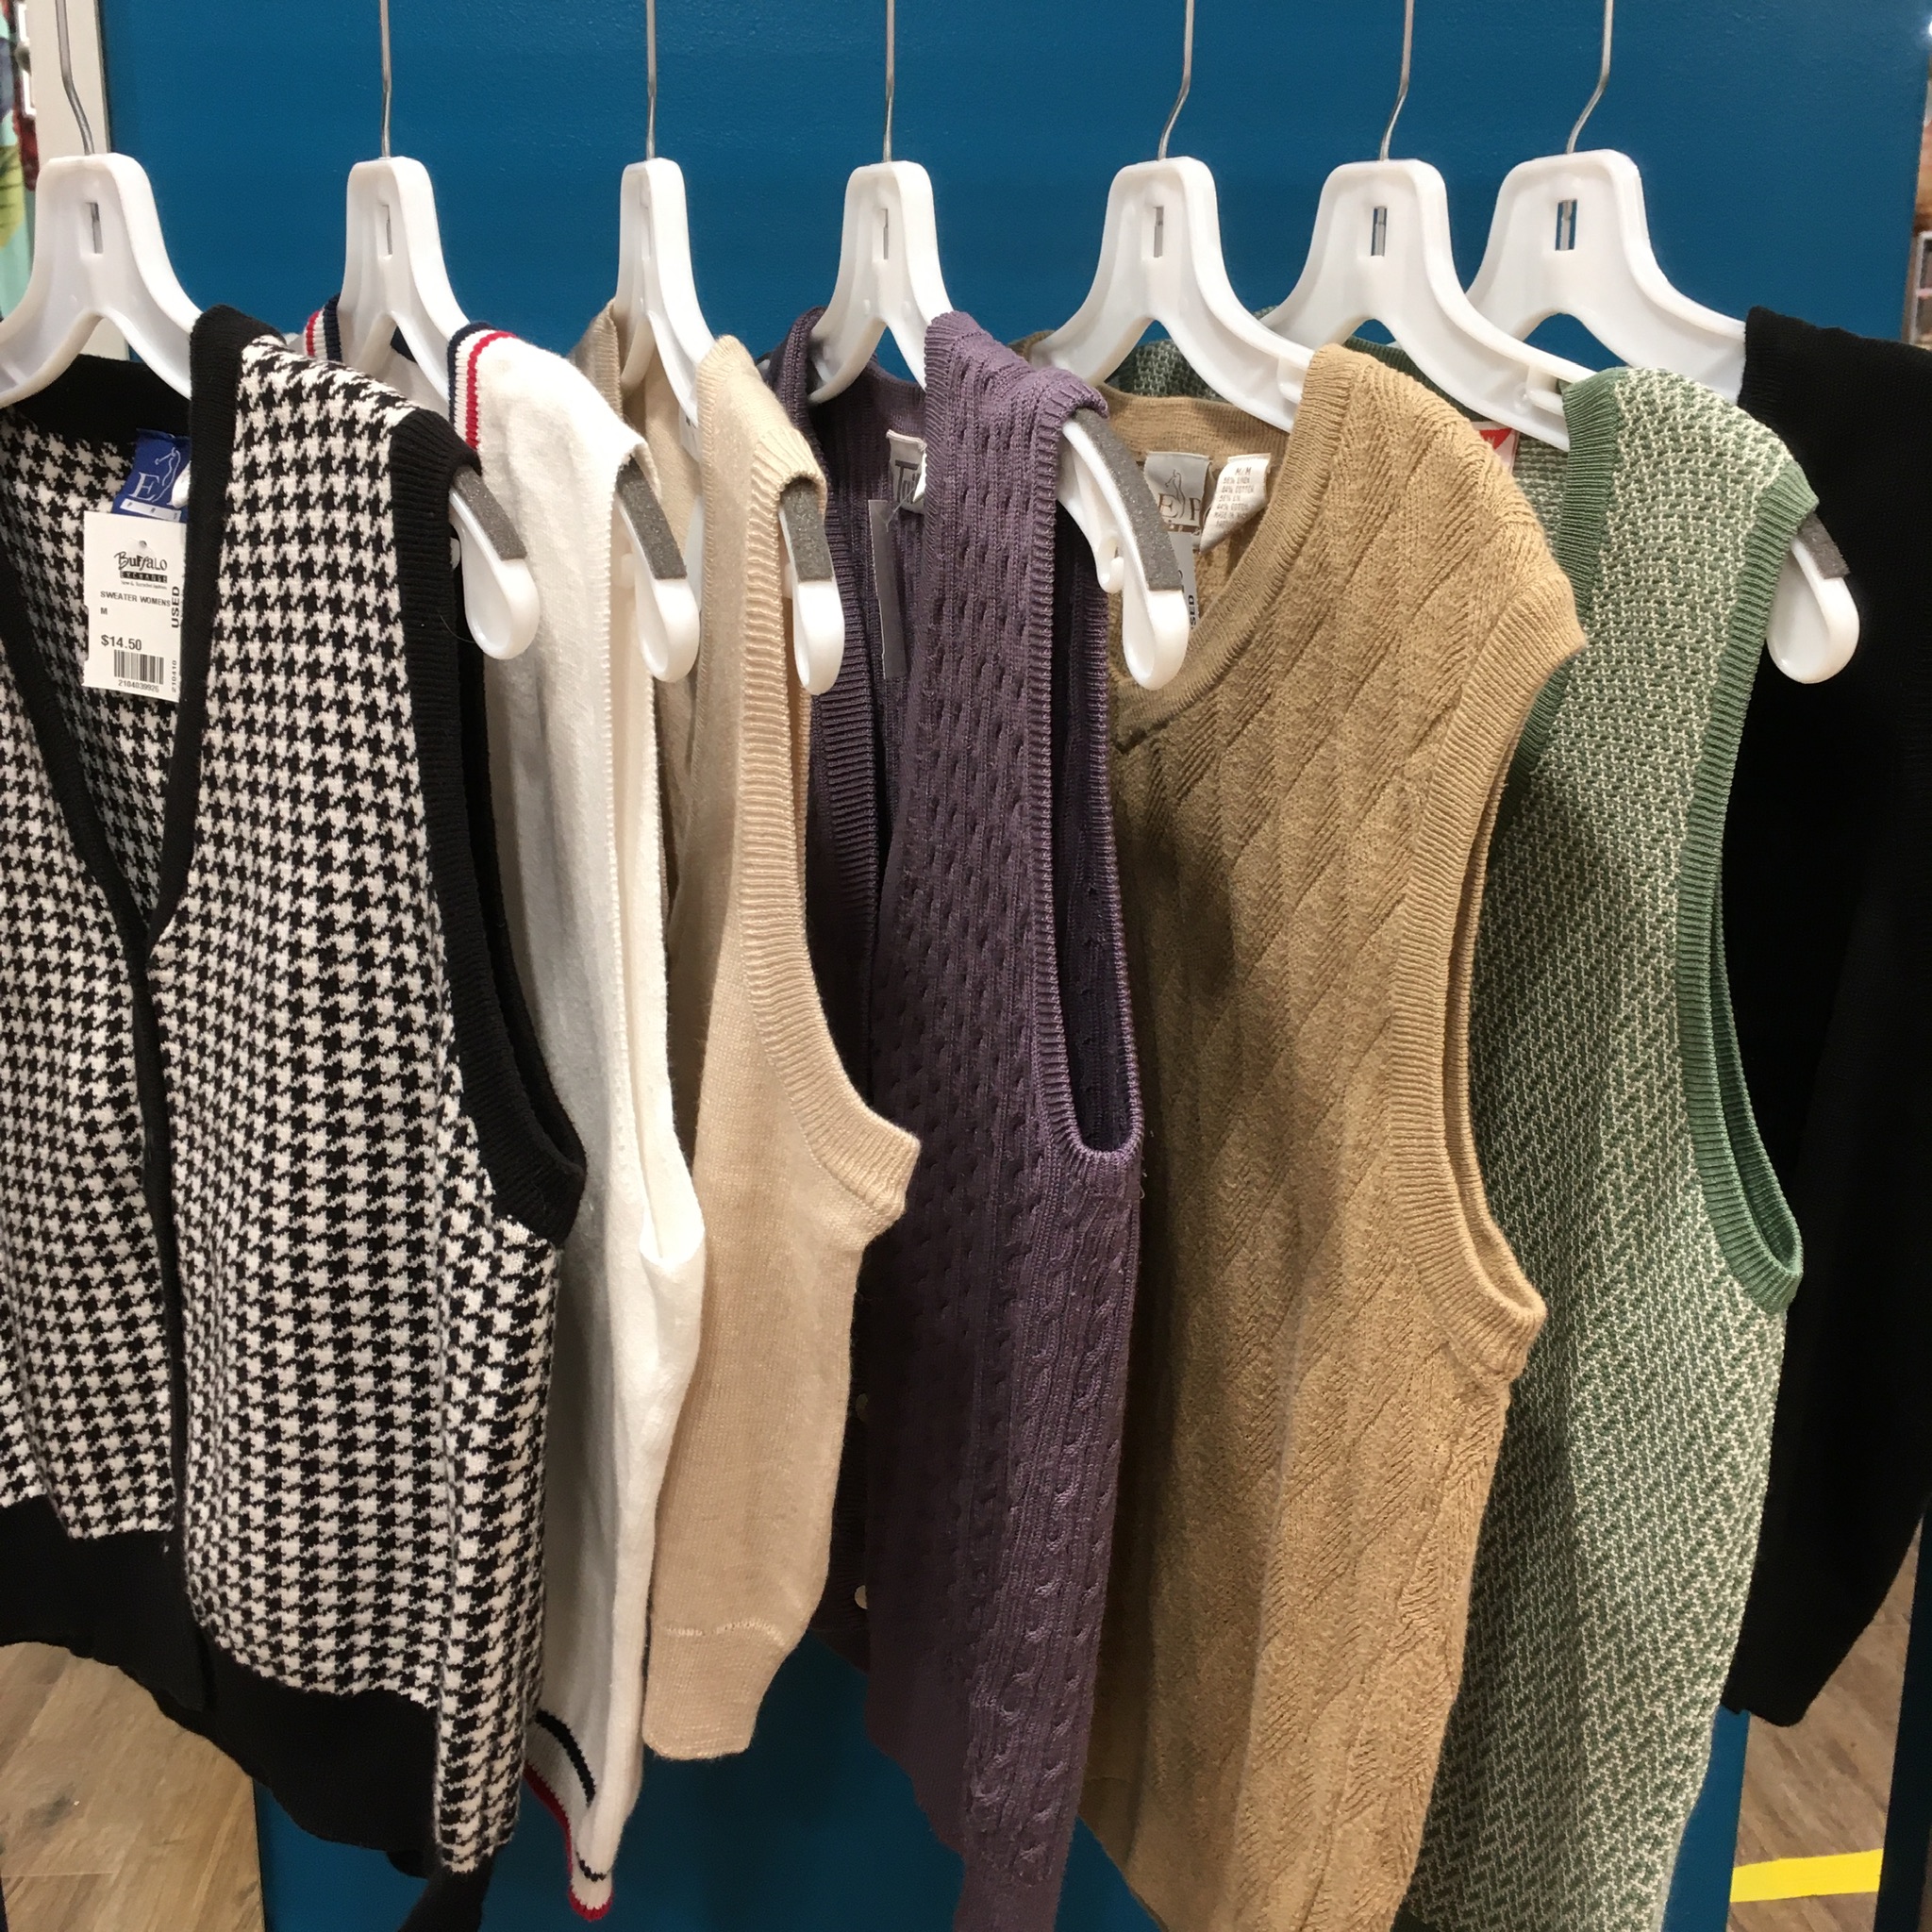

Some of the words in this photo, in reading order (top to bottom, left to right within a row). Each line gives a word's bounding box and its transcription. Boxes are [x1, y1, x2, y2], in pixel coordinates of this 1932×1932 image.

[120, 570, 168, 584] EXCHANGE
[100, 591, 138, 602] SWEATER
[140, 595, 171, 608] WOMENS
[171, 586, 180, 628] USED
[100, 607, 108, 615] M
[1188, 594, 1197, 630] SED
[100, 634, 142, 651] $14.50
